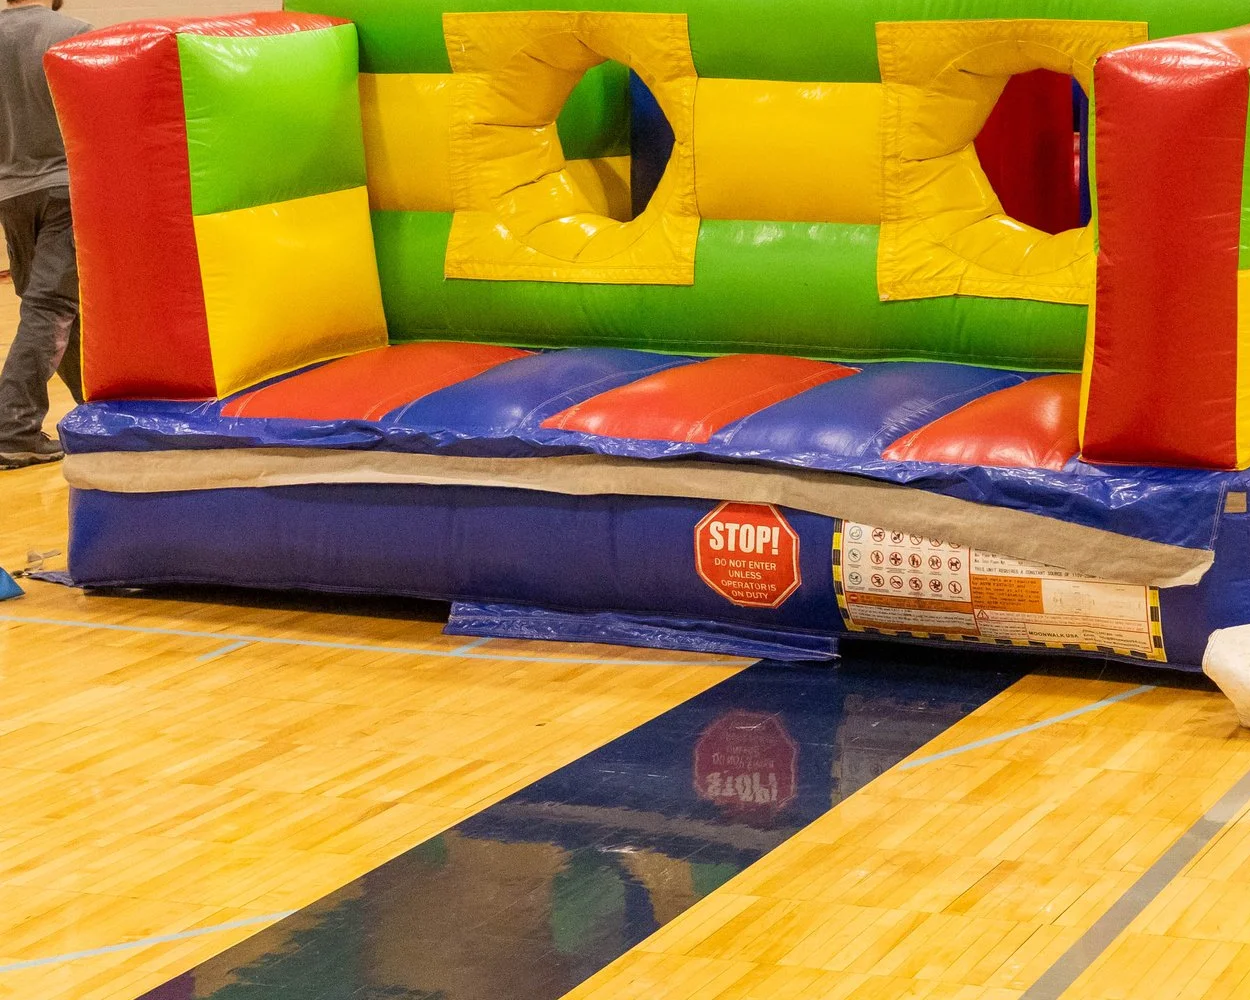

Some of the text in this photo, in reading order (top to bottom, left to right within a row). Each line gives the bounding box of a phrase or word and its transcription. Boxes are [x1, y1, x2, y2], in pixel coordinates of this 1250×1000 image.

[709, 521, 780, 555] STOP!
[714, 557, 777, 571] DO NOT ENTER
[728, 570, 762, 580] UNLESS
[721, 579, 777, 592] OPERATOR IS
[731, 590, 769, 600] ON DUTY
[1028, 631, 1065, 639] MOONWALK
